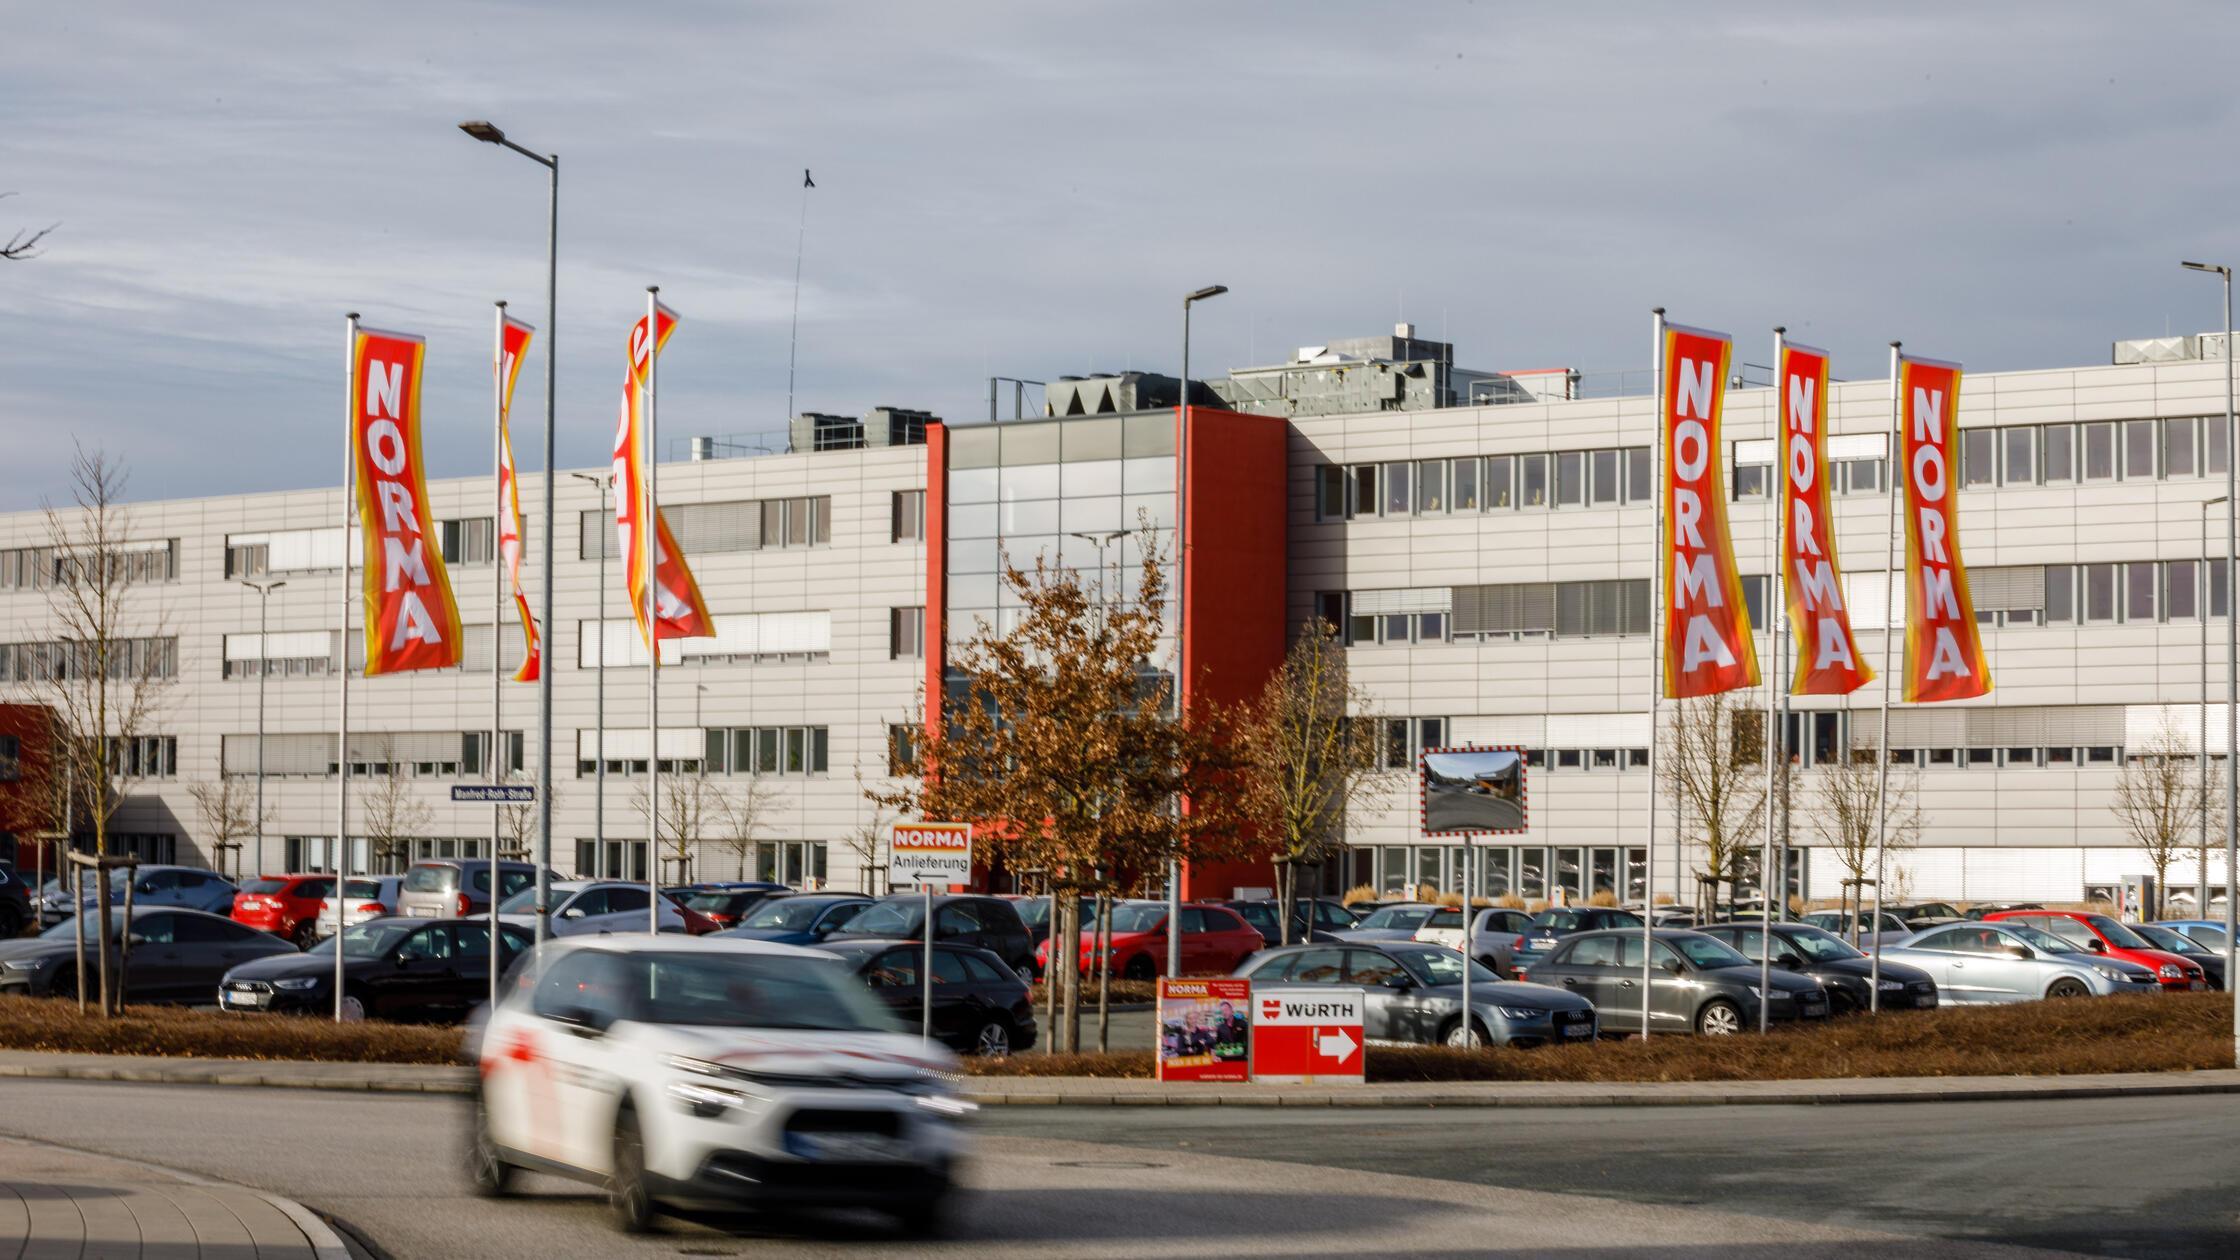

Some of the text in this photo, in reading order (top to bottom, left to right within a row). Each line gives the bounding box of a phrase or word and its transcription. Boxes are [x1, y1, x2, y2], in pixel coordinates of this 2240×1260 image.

[366, 358, 442, 652] NORMA
[1674, 356, 1737, 673] NORMA
[1789, 373, 1856, 671] NORMA
[1913, 387, 1972, 681] NORMA
[893, 855, 968, 872] Anlieferung
[895, 830, 966, 847] NORMA
[1167, 984, 1208, 995] NORMA
[1286, 1003, 1354, 1017] WÜRTH
